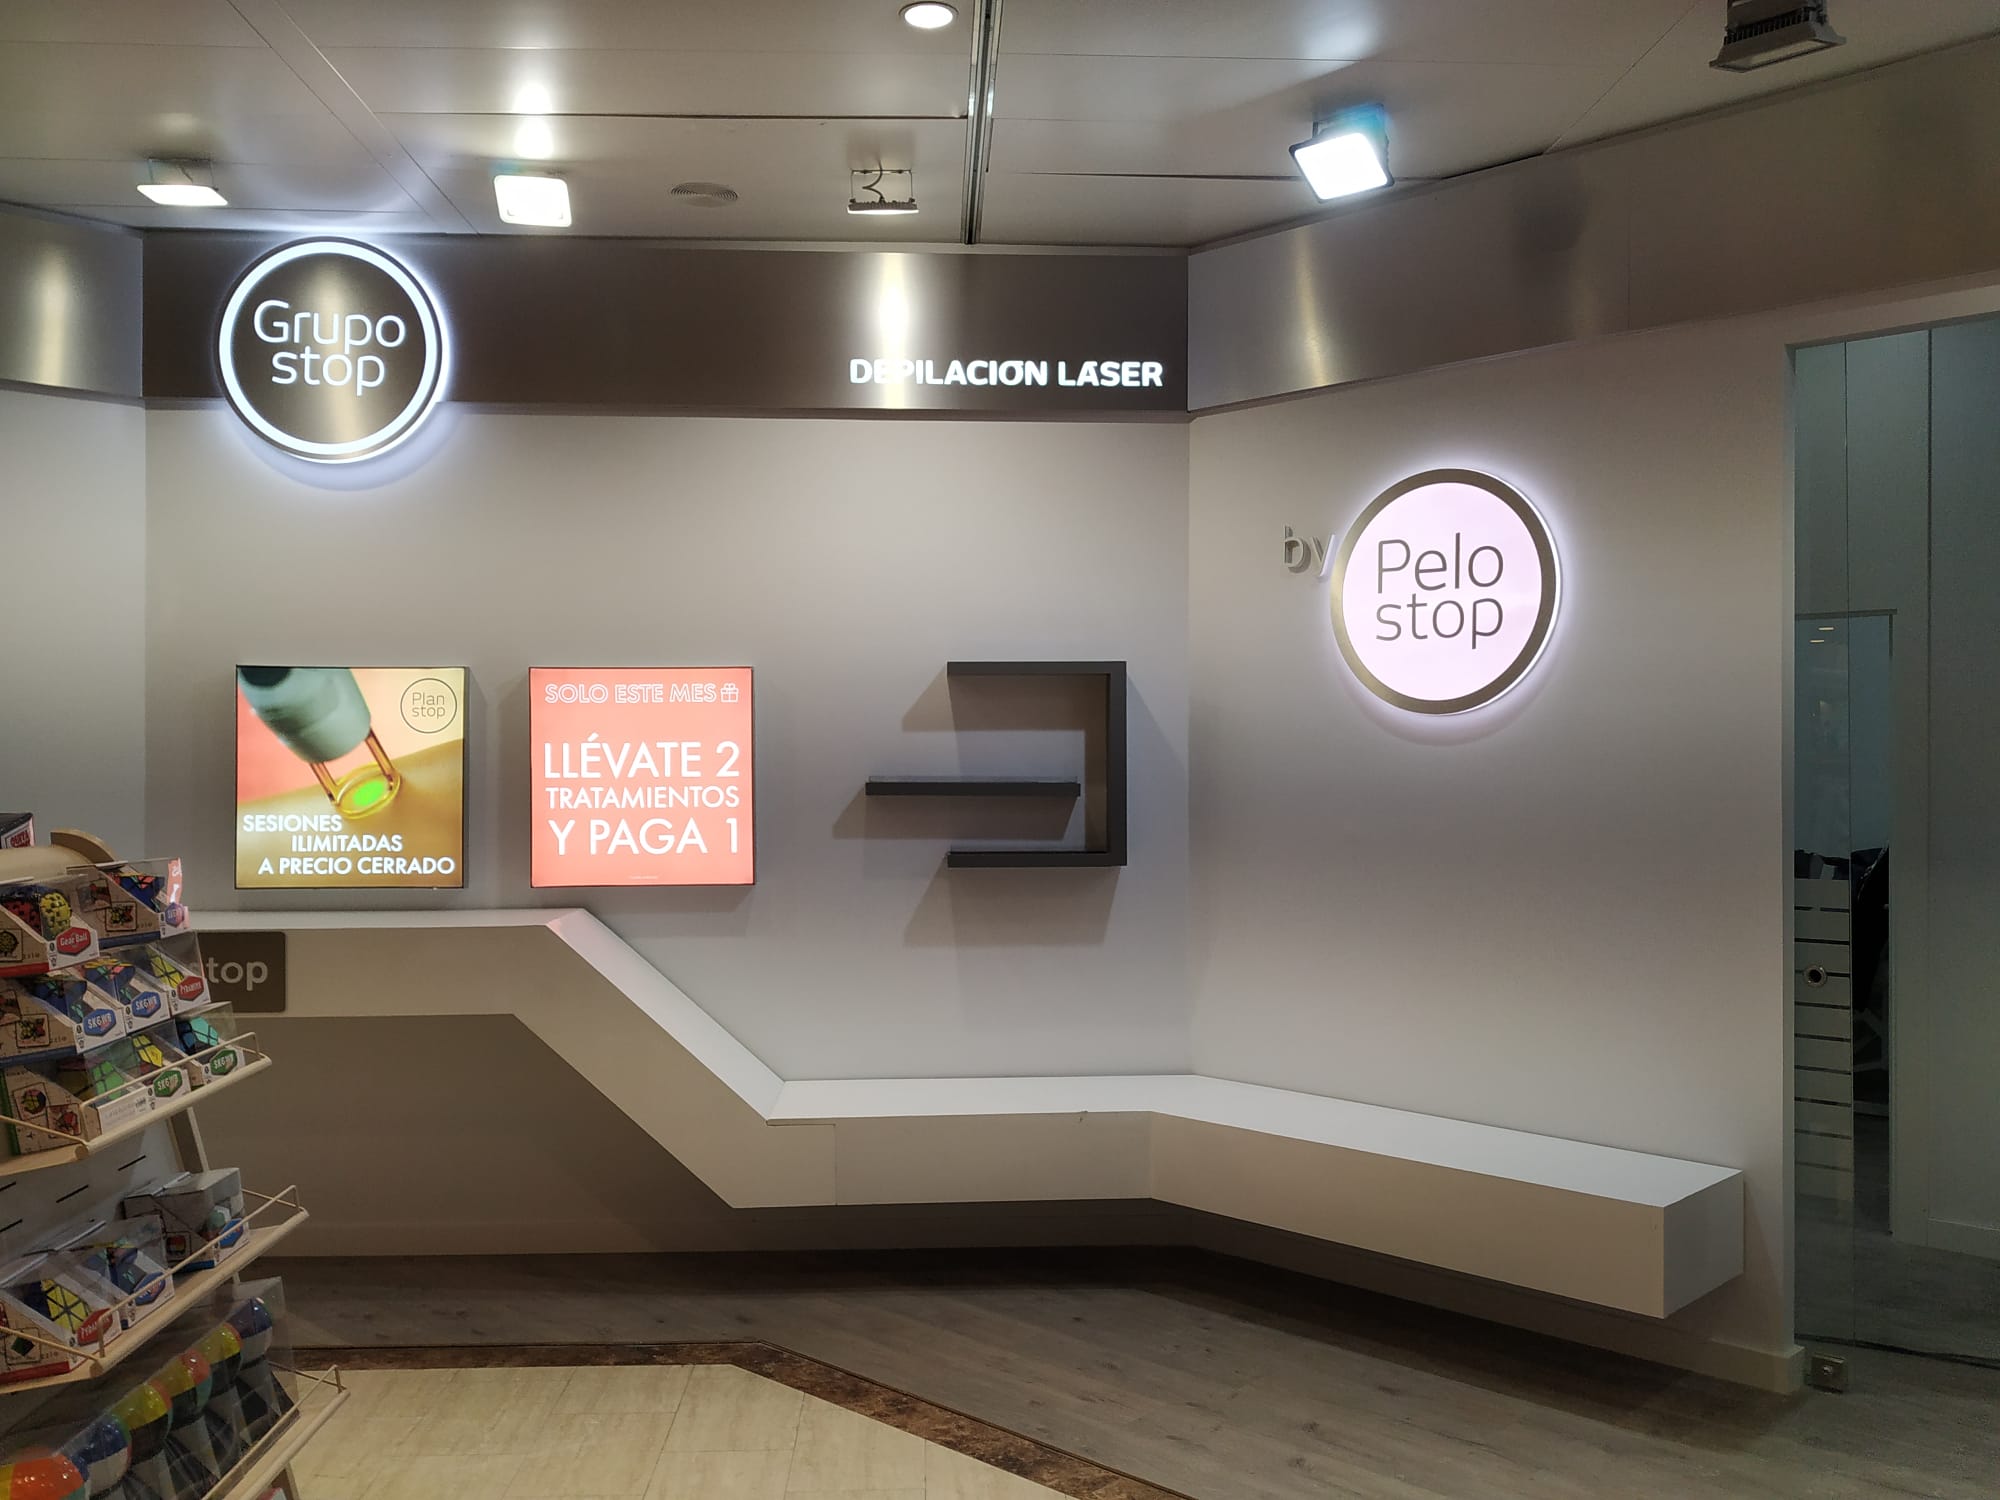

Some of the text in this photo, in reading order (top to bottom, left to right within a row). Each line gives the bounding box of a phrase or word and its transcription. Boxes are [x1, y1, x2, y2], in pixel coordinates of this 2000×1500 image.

[253, 300, 406, 354] Grupo
[271, 346, 385, 396] stop
[1057, 360, 1164, 387] LÁSER
[1283, 523, 1337, 577] by
[1377, 532, 1504, 594] Pelo
[1376, 593, 1504, 650] stop
[412, 691, 445, 705] Plan
[544, 682, 717, 704] SOLO ESTE MES
[411, 706, 446, 720] stop
[543, 732, 740, 779] LLÉVATE 2
[545, 785, 740, 809] TRATAMIENTOS
[242, 815, 343, 832] SESIONES
[548, 817, 738, 856] Y PAGA 1
[291, 834, 403, 852] ILIMITADAS
[257, 857, 456, 875] A PRECIO CERRADO
[205, 956, 268, 991] top
